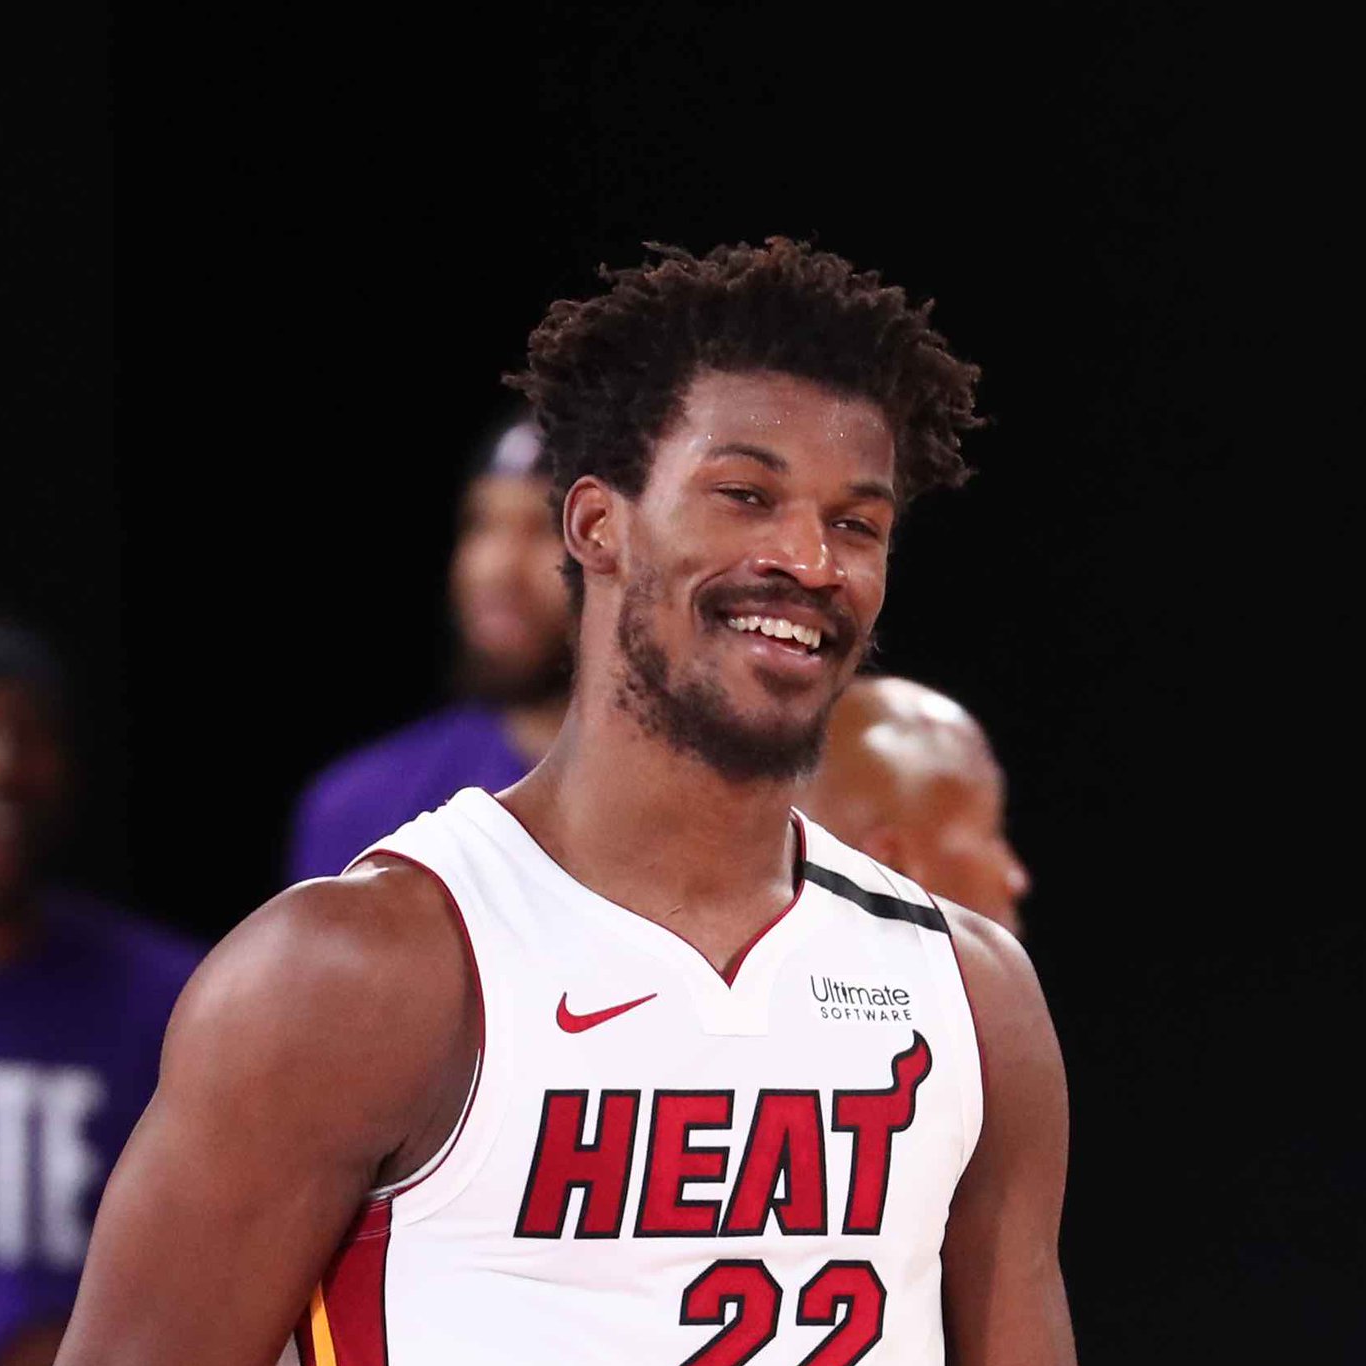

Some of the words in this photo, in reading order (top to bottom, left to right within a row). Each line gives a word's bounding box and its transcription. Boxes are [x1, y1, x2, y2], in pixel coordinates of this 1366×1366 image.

[810, 974, 910, 1006] Ultimate
[820, 1006, 912, 1021] SOFTWARE
[513, 1029, 933, 1239] HEAT
